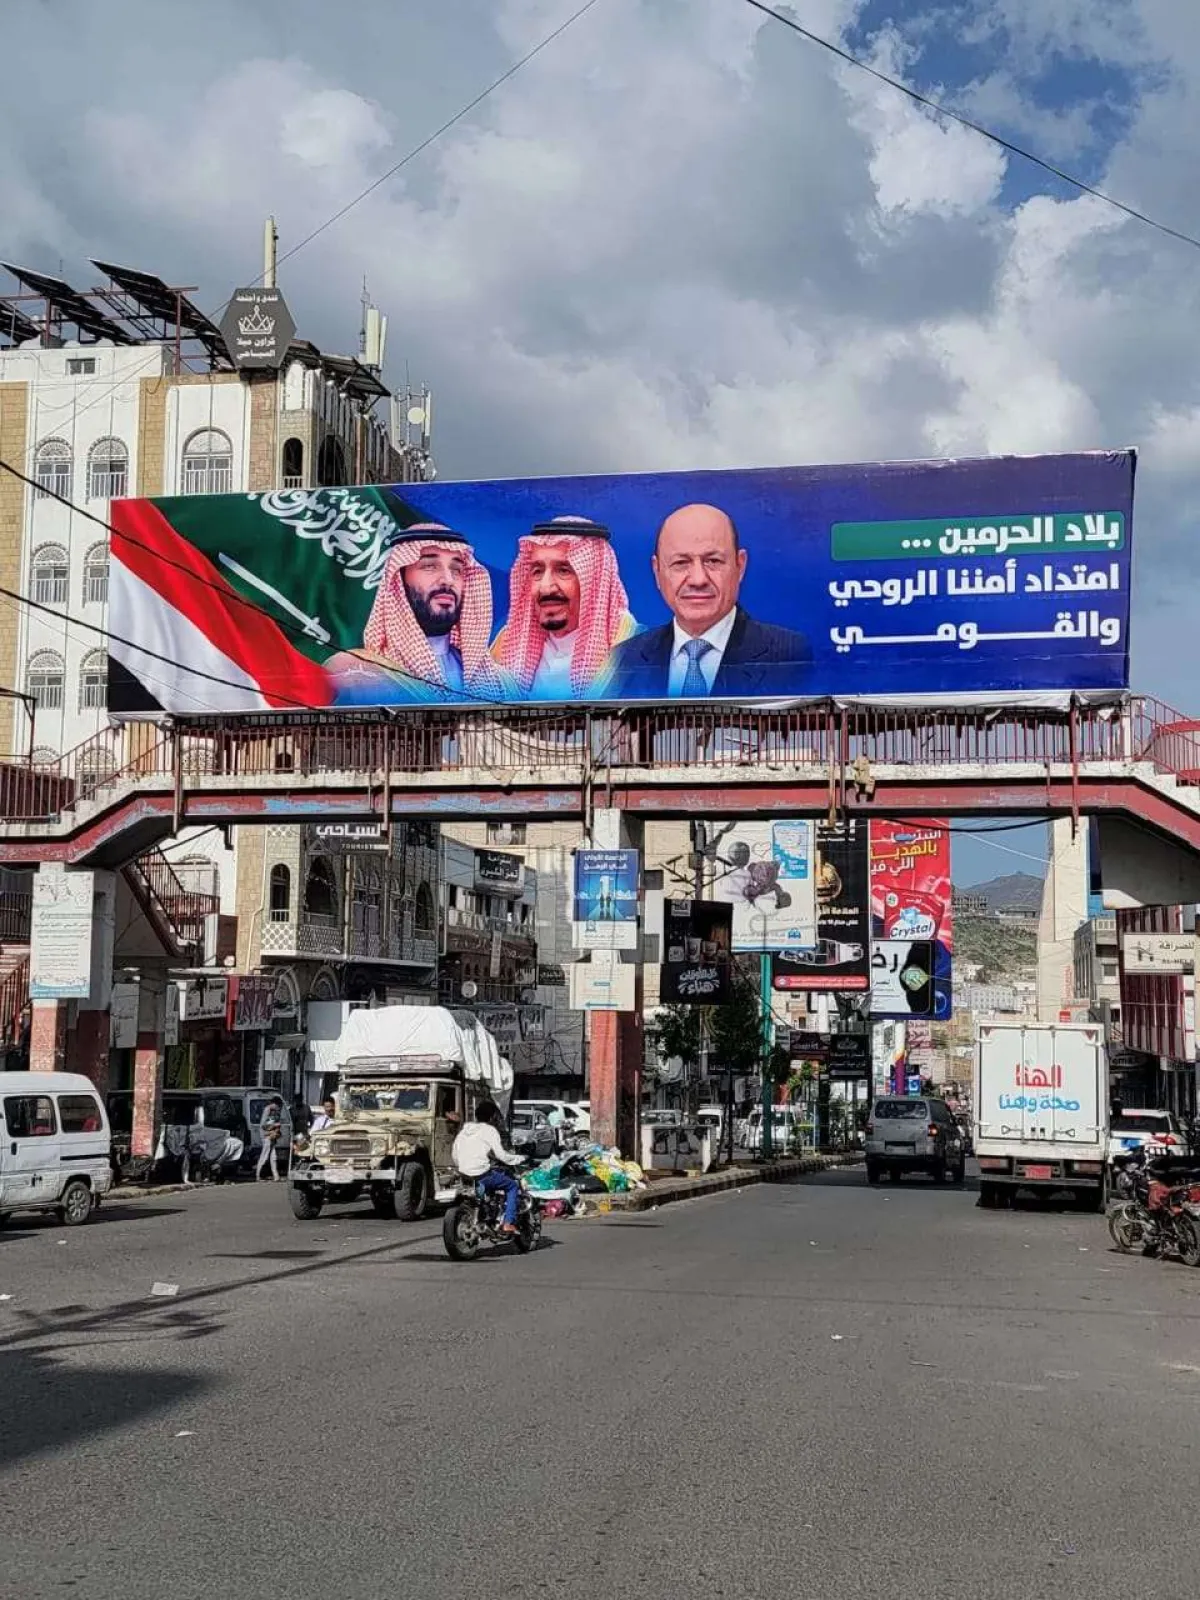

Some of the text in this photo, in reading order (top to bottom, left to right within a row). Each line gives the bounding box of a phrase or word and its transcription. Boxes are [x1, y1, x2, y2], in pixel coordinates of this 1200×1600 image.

[938, 516, 1054, 554] الحرمين
[1064, 514, 1120, 548] بلاد
[828, 559, 1120, 607] امتداد أمننا الروحي
[315, 822, 381, 840] لسياحي
[891, 922, 933, 938] Crystal
[1015, 1063, 1063, 1089] الهنا
